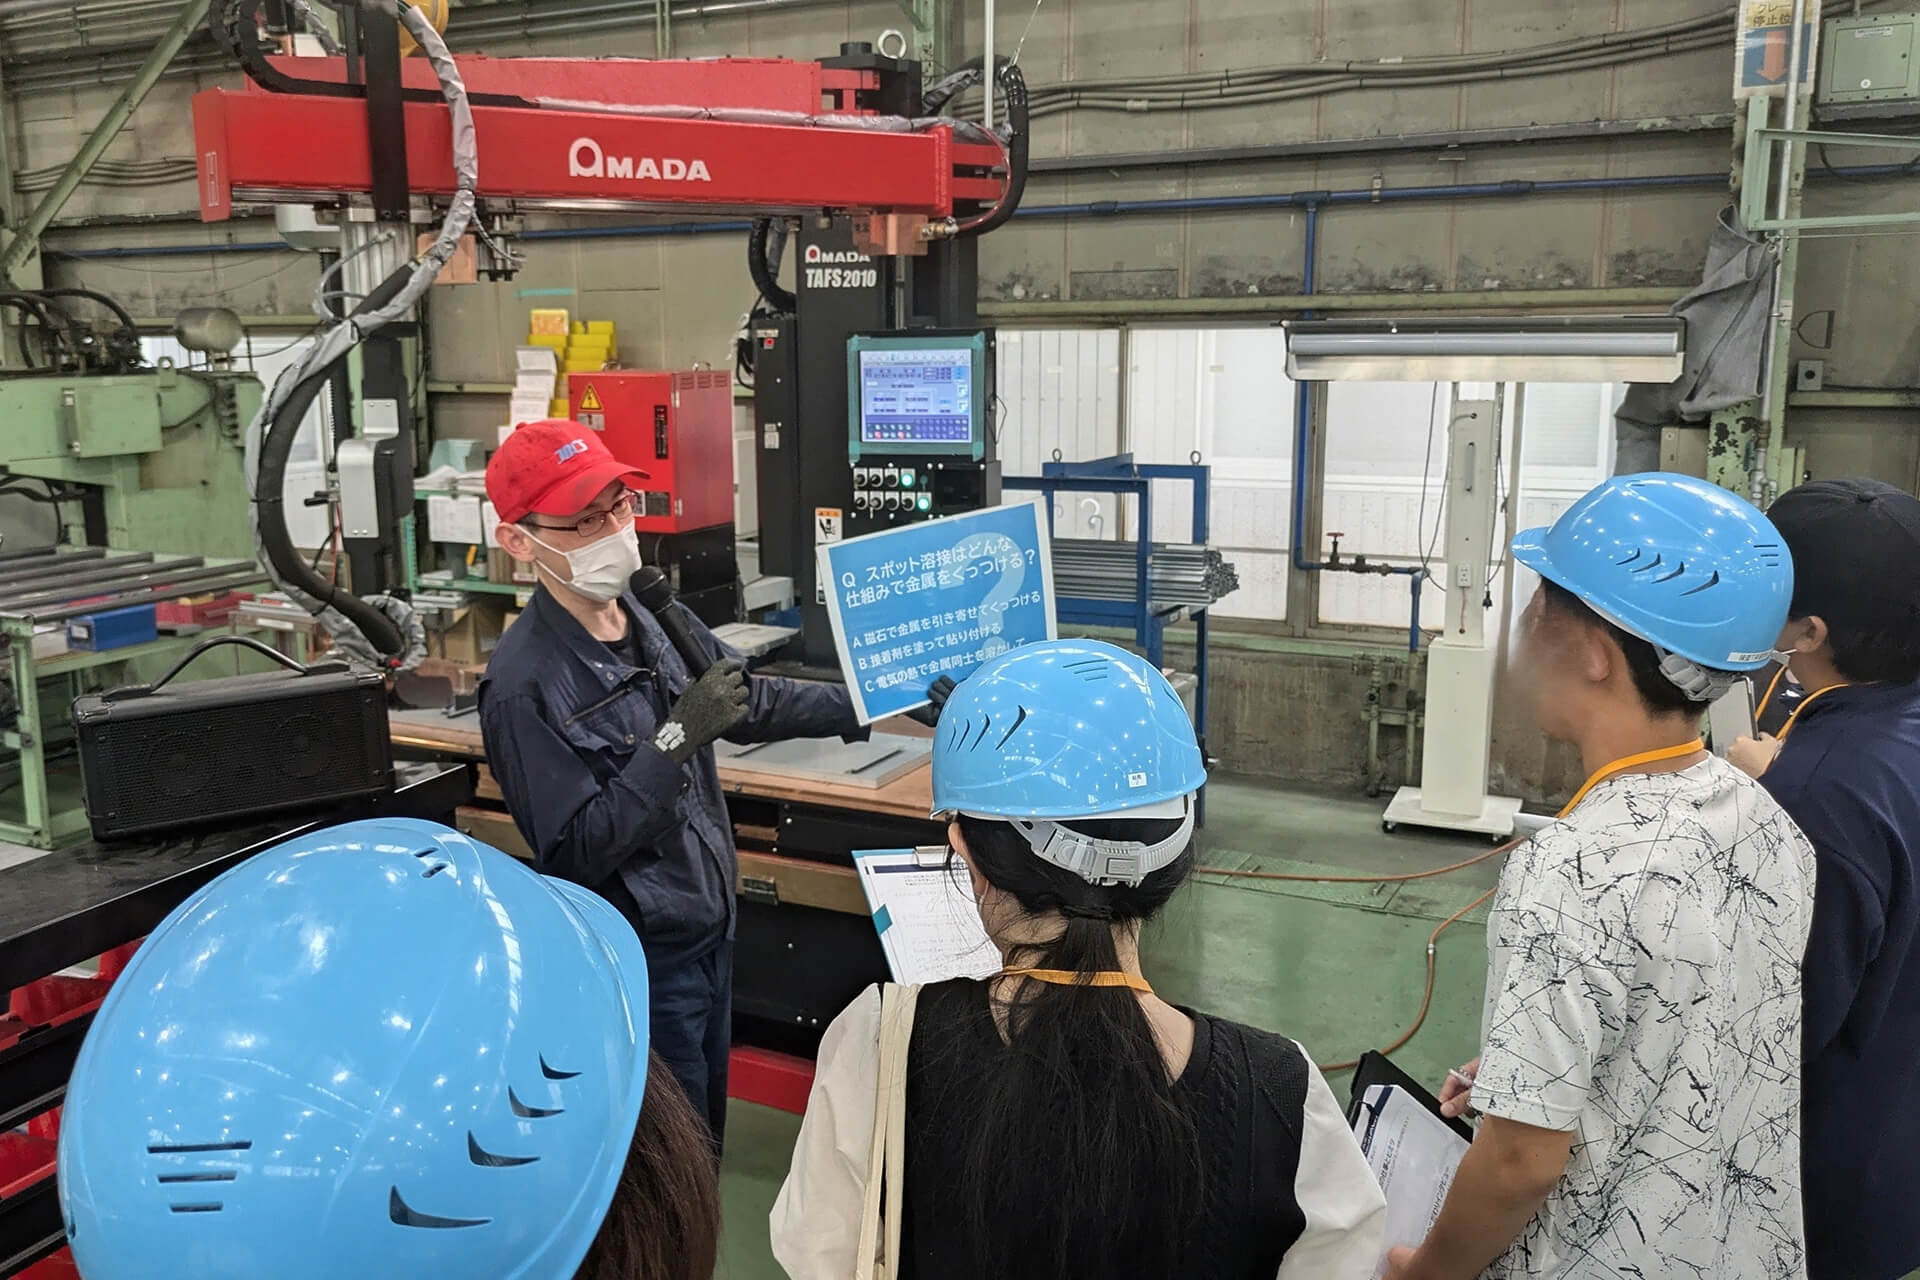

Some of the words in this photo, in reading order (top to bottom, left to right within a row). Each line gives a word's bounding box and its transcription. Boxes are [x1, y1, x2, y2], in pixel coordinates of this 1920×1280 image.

[1752, 15, 1793, 27] 停止位
[568, 137, 712, 182] AMADA
[804, 244, 876, 264] AMADA
[805, 267, 878, 289] TAFS2010
[841, 571, 857, 589] Q
[865, 537, 1013, 583] スポット溶接はどんな
[852, 636, 863, 649] A
[864, 590, 1041, 646] 磁石で金属を引き寄せてくっつける
[858, 657, 868, 670] B
[869, 622, 1001, 669] 接着剤を塗って貼り付ける
[864, 679, 875, 693] C
